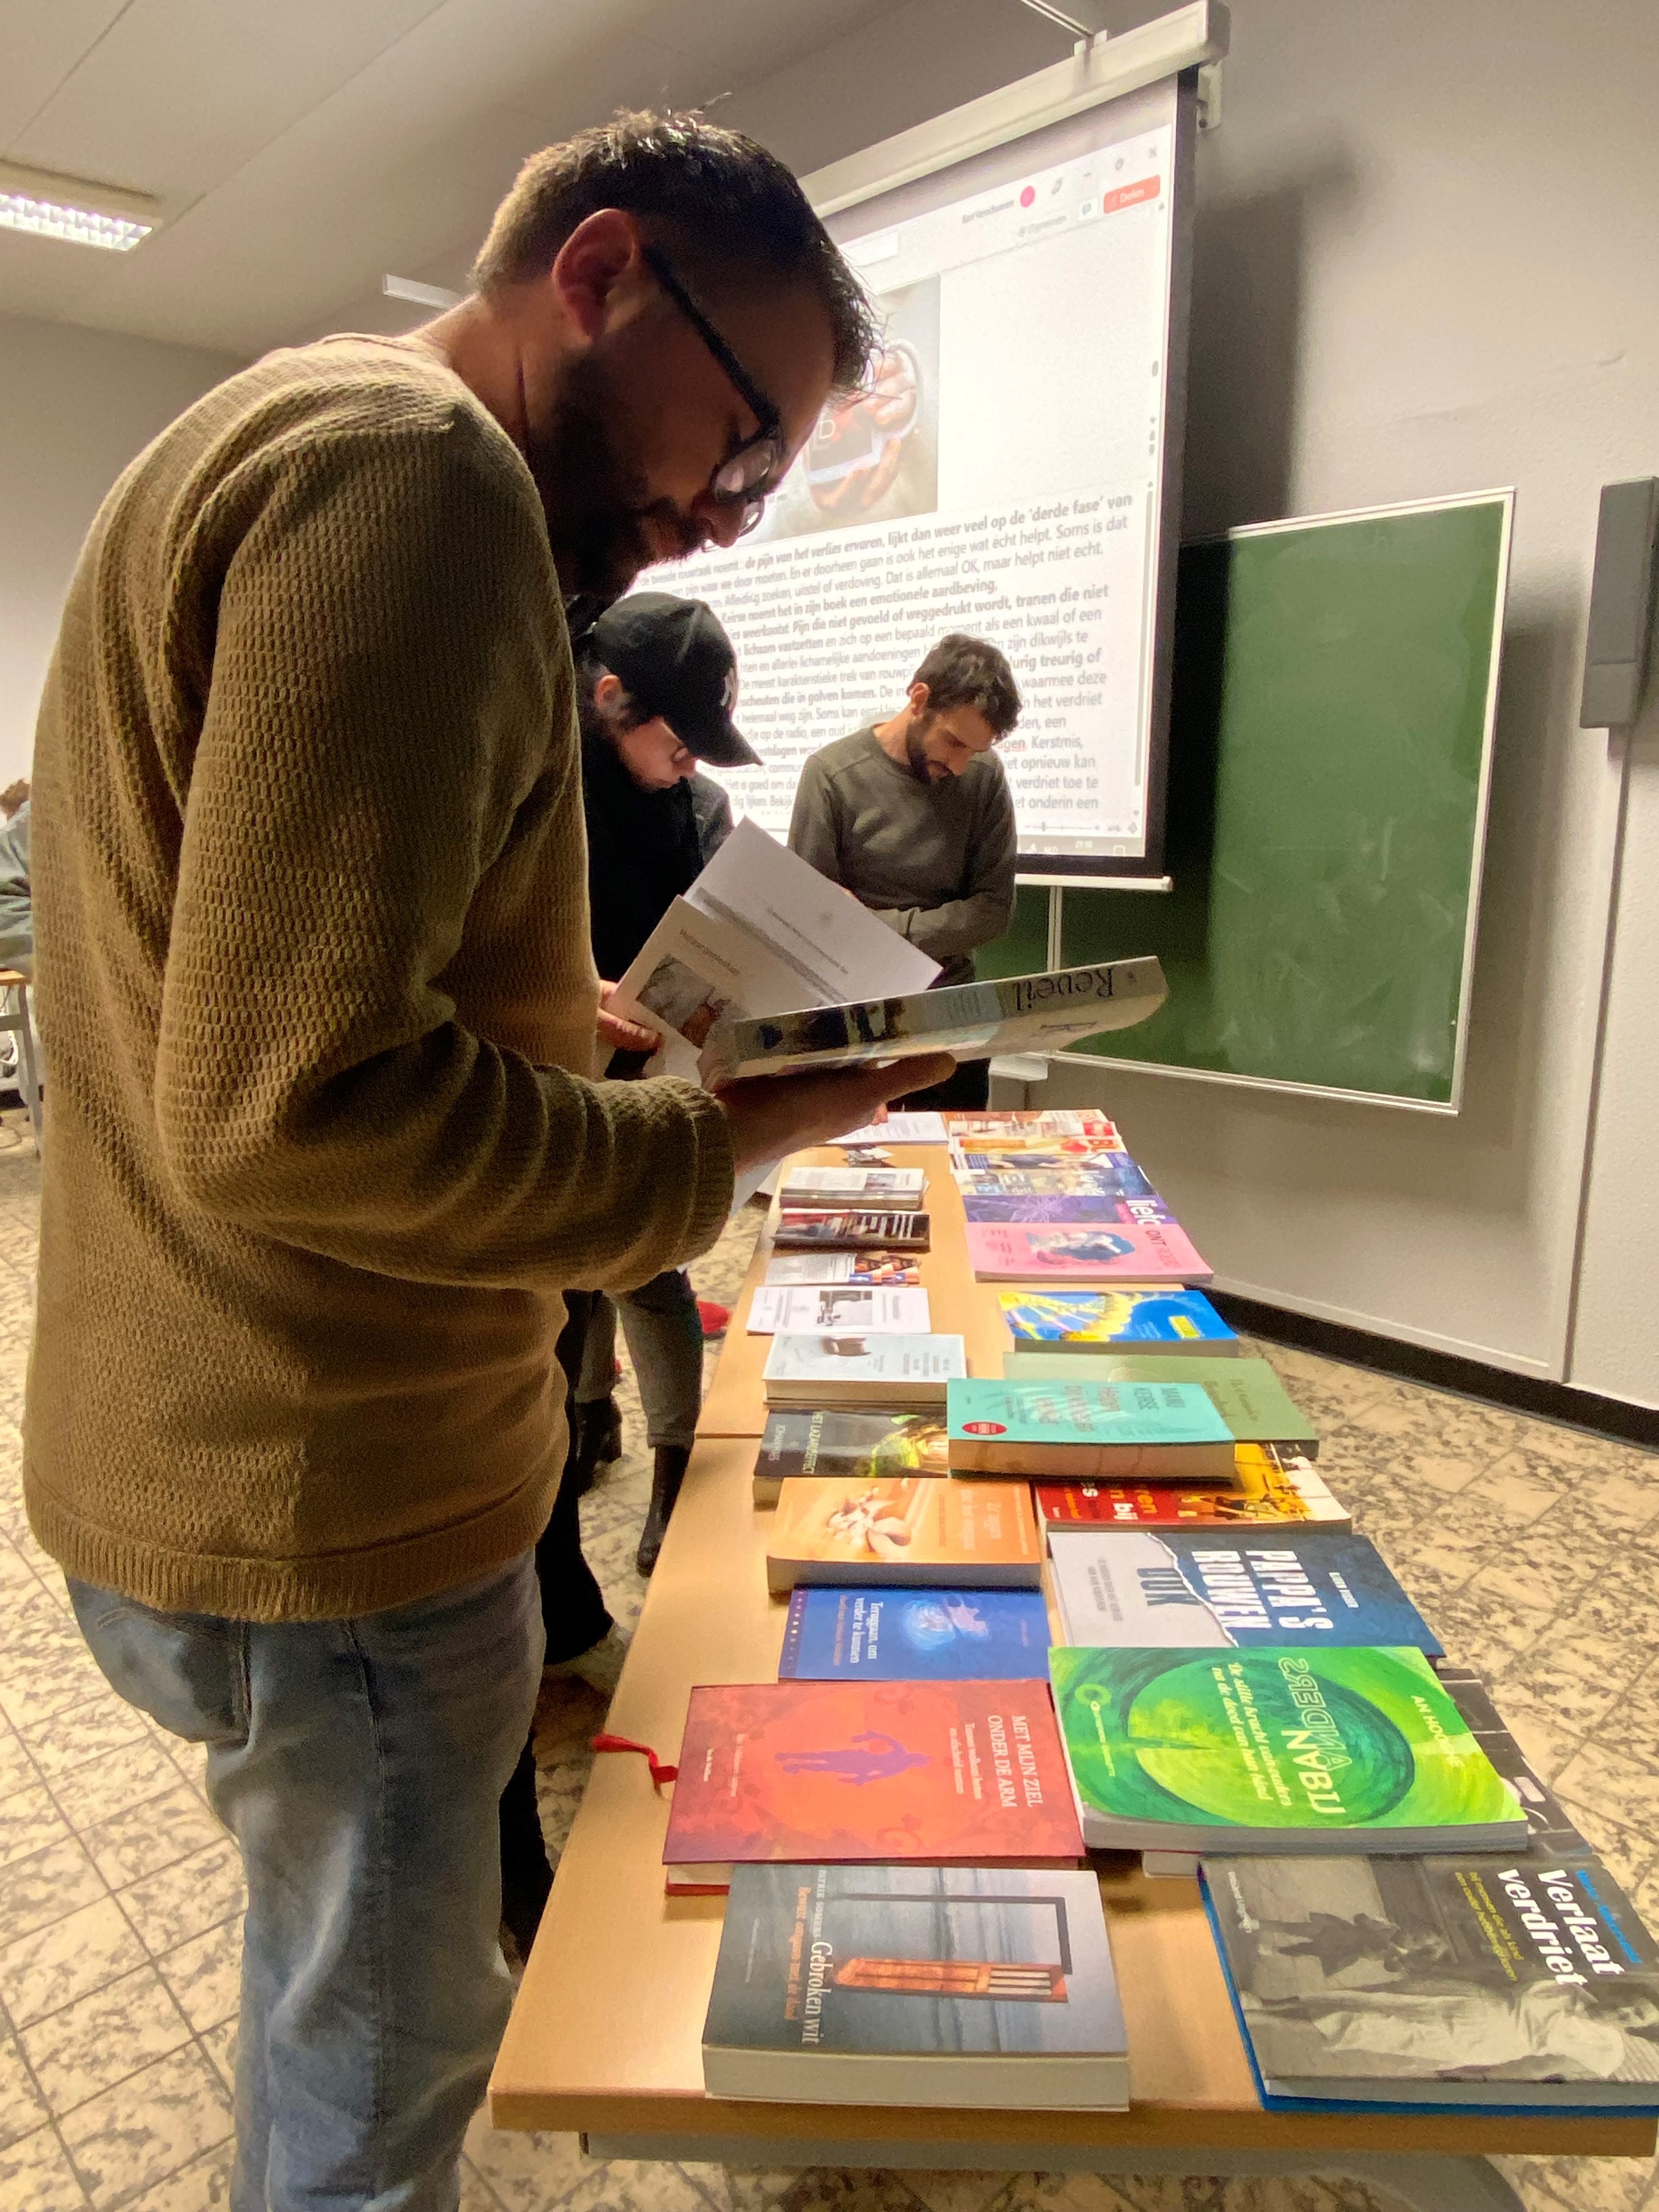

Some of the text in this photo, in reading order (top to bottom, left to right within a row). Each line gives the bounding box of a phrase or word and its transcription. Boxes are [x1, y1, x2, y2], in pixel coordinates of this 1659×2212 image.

[794, 545, 809, 561] het
[887, 528, 909, 549] lijkt
[911, 524, 932, 541] dan
[934, 523, 961, 538] weer
[963, 514, 988, 533] veel
[990, 516, 1007, 532] op
[1009, 507, 1026, 525] de
[1106, 494, 1132, 509] van
[859, 556, 884, 572] gaan
[896, 546, 916, 563] ook
[918, 543, 936, 560] het
[937, 538, 967, 561] enige
[969, 534, 990, 552] wat
[992, 530, 1017, 549] echt
[1019, 524, 1053, 549] helpt.
[1056, 518, 1090, 539] Soms
[1092, 516, 1103, 534] is
[1105, 512, 1128, 532] dat
[885, 568, 904, 584] Dat
[905, 567, 914, 582] is
[916, 560, 959, 580] allemaal
[961, 557, 981, 577] OK,
[983, 557, 1012, 571] maar
[1014, 548, 1044, 570] helpt
[1047, 544, 1071, 562] niet
[1073, 539, 1104, 558] echt.
[822, 596, 847, 611] boek
[849, 597, 868, 608] een
[869, 584, 929, 606] emotionele
[828, 614, 847, 629] niet
[849, 608, 890, 630] gevoeld
[891, 607, 904, 622] of
[905, 599, 972, 624] weggedrukt
[973, 594, 1012, 616] wordt,
[1015, 588, 1056, 608] tranen
[1059, 585, 1080, 603] die
[1082, 582, 1109, 600] niet
[873, 631, 893, 642] een
[894, 623, 935, 644] bepaald
[984, 616, 1000, 631] als
[1002, 617, 1024, 629] een
[1025, 610, 1059, 627] kwaal
[1062, 608, 1076, 624] of
[1079, 608, 1102, 622] een
[1007, 627, 1088, 653] zijn dikwijls te
[851, 644, 921, 667] aandoeningen
[1040, 649, 1084, 671] treurig
[1086, 647, 1102, 663] of
[1020, 669, 1107, 689] waarmee deze
[1033, 690, 1103, 709] het verdriet
[1044, 718, 1066, 728] een
[1020, 754, 1071, 772] opnieuw
[1074, 753, 1097, 768] kan
[1015, 774, 1099, 789] verdriet toe te
[1028, 794, 1074, 809] onderin
[1076, 798, 1098, 809] een
[1192, 1550, 1273, 1629] ROUWEN
[1245, 1550, 1334, 1629] PAPPA'S
[1227, 1662, 1245, 1676] De
[1234, 1678, 1255, 1703] stille
[1411, 1696, 1430, 1713] AN
[1211, 1667, 1274, 1800] na de dood van hun kind
[1243, 1707, 1269, 1743] kracht
[986, 1714, 1019, 1808] ONDER DE ARM
[1011, 1715, 1044, 1808] MET MIJN ZIEL
[1258, 1746, 1279, 1769] van
[1491, 1914, 1505, 1928] die
[1500, 1927, 1511, 1940] als
[1506, 1941, 1525, 1960] kind
[1498, 1869, 1588, 1985] verdriet
[1538, 1870, 1625, 1974] Verlaat
[805, 1942, 833, 2015] Gebroken
[802, 2019, 825, 2044] wit
